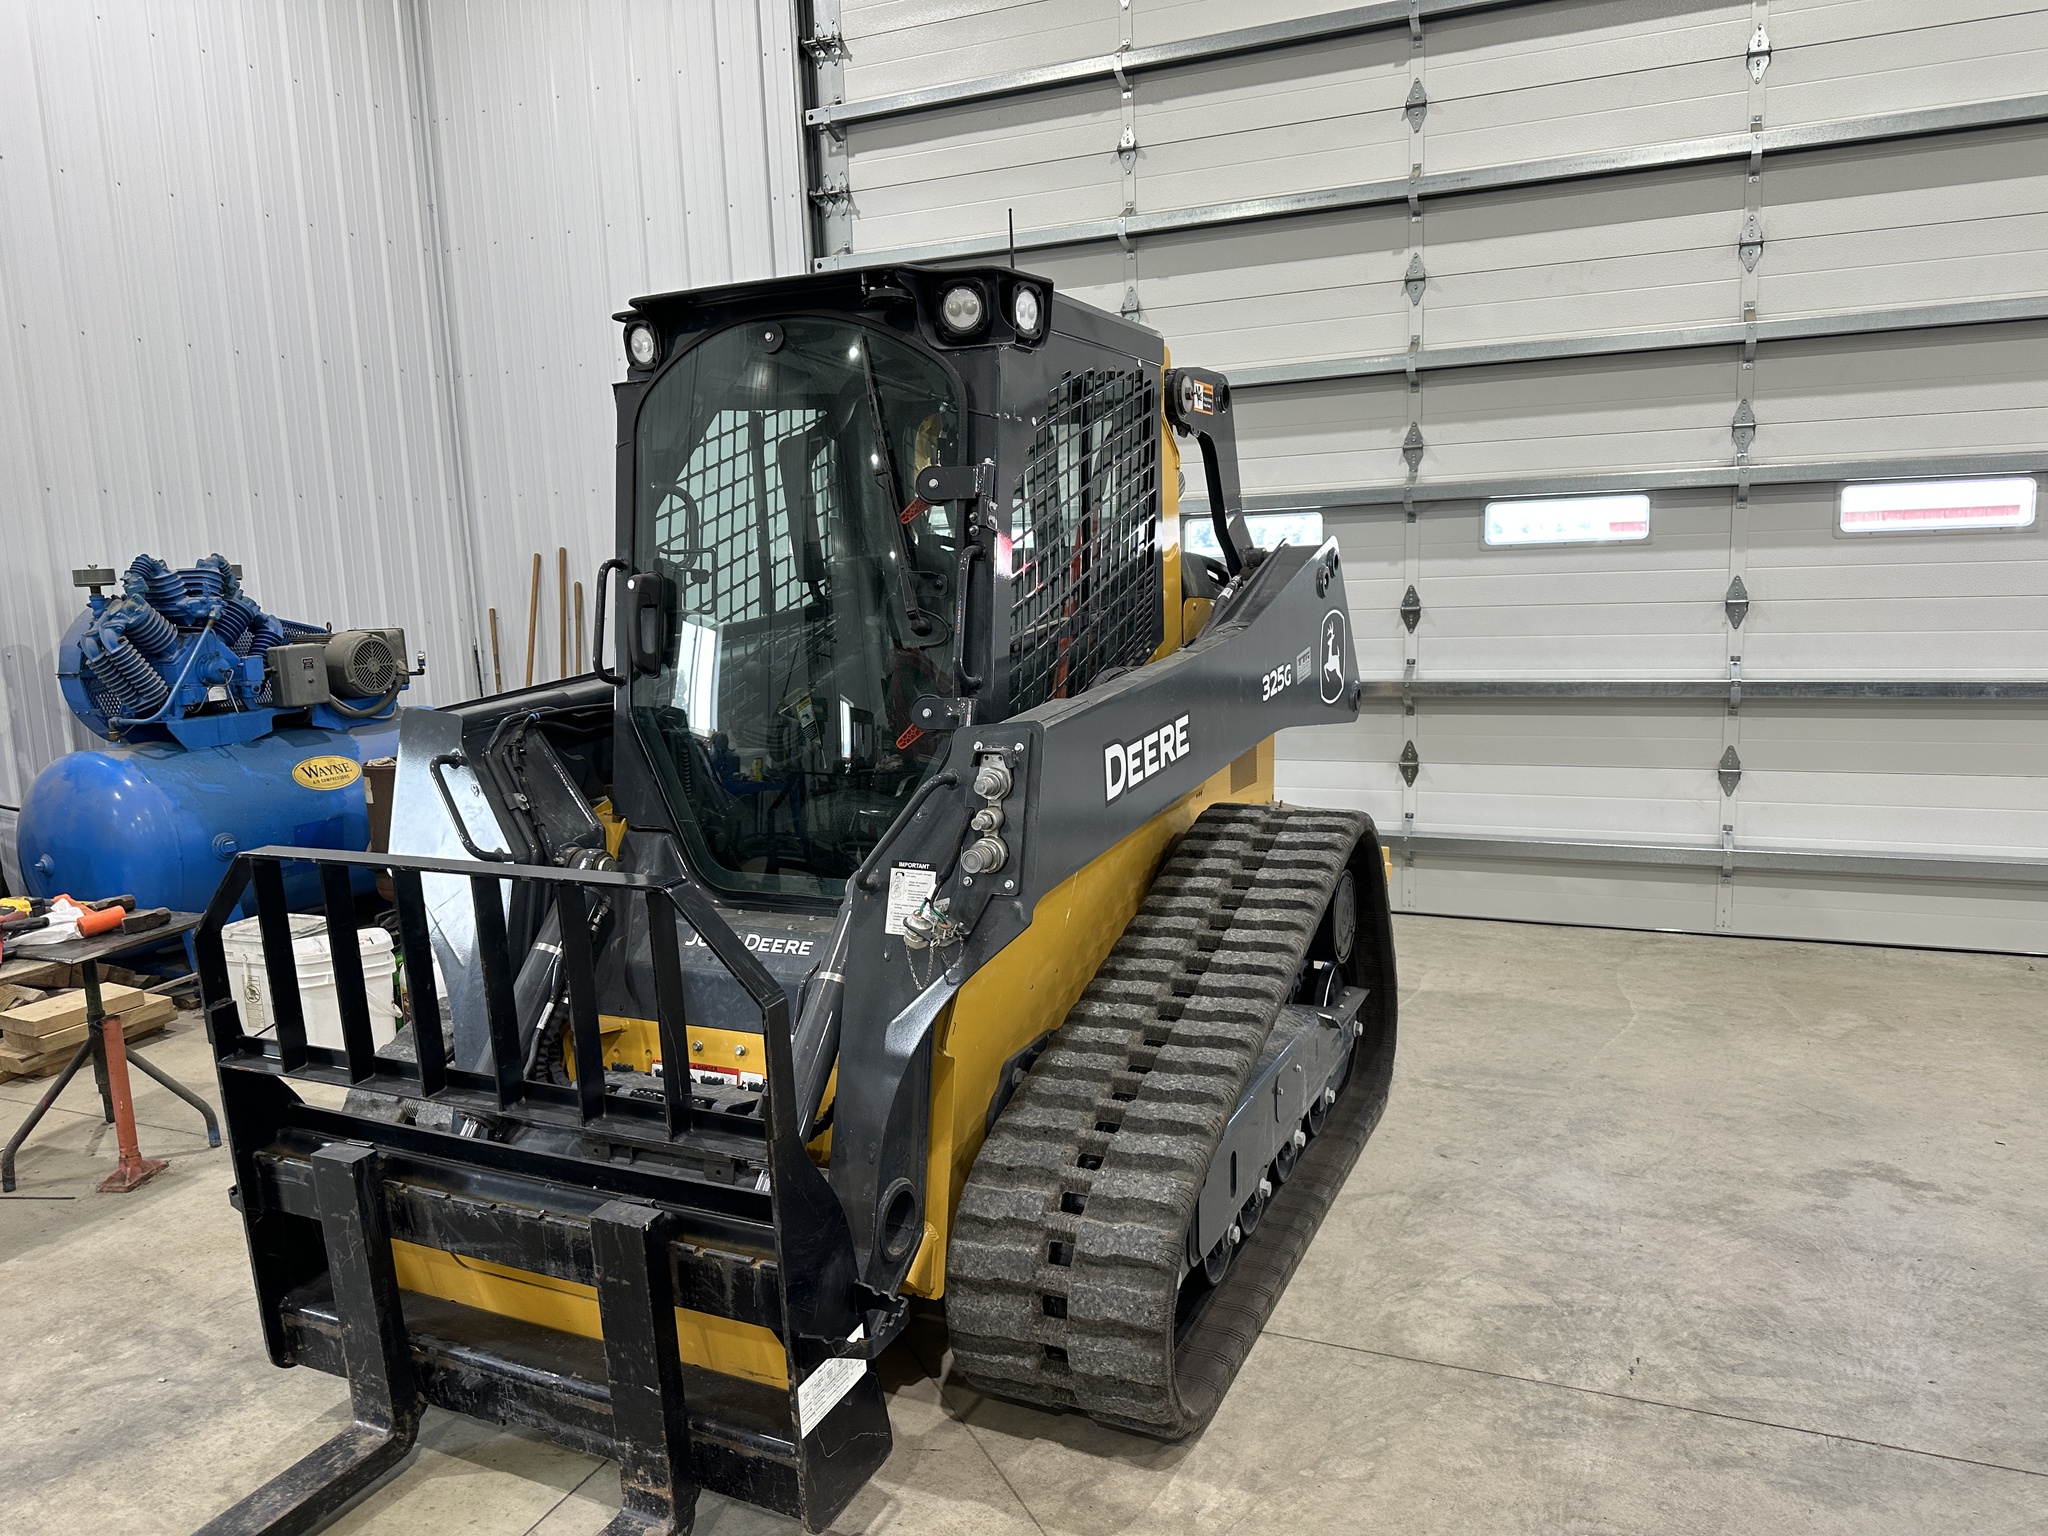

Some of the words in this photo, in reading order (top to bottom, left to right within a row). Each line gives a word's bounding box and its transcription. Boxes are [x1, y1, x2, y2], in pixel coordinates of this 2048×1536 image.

[1262, 664, 1291, 701] 325G
[1105, 714, 1190, 801] DEERE
[301, 763, 352, 778] WAYNE
[898, 861, 930, 869] IMPORTANT
[744, 933, 815, 956] DEERE
